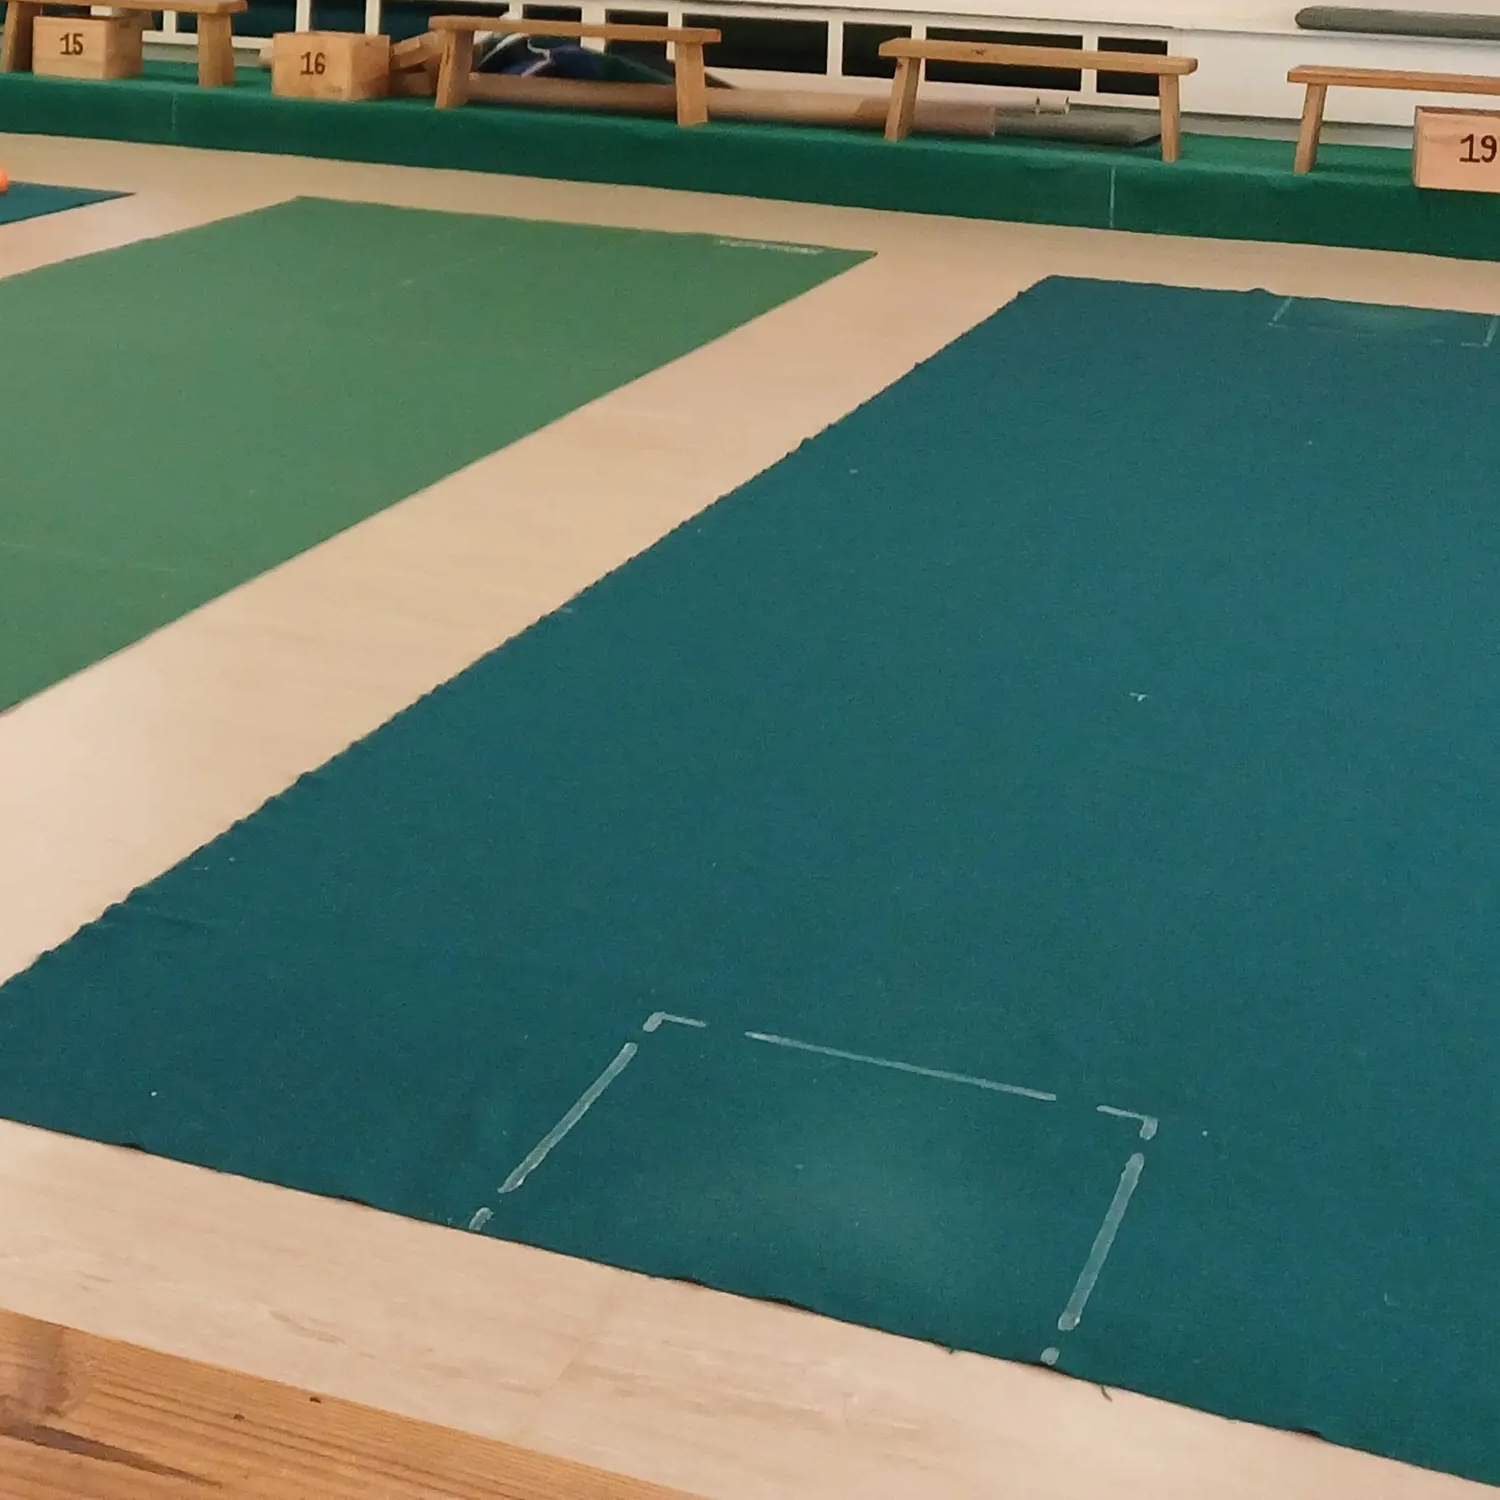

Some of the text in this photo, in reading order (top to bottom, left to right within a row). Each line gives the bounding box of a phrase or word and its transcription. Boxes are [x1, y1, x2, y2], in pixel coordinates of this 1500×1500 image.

[59, 32, 84, 55] 15
[300, 51, 326, 75] 16
[1459, 133, 1497, 163] 19
